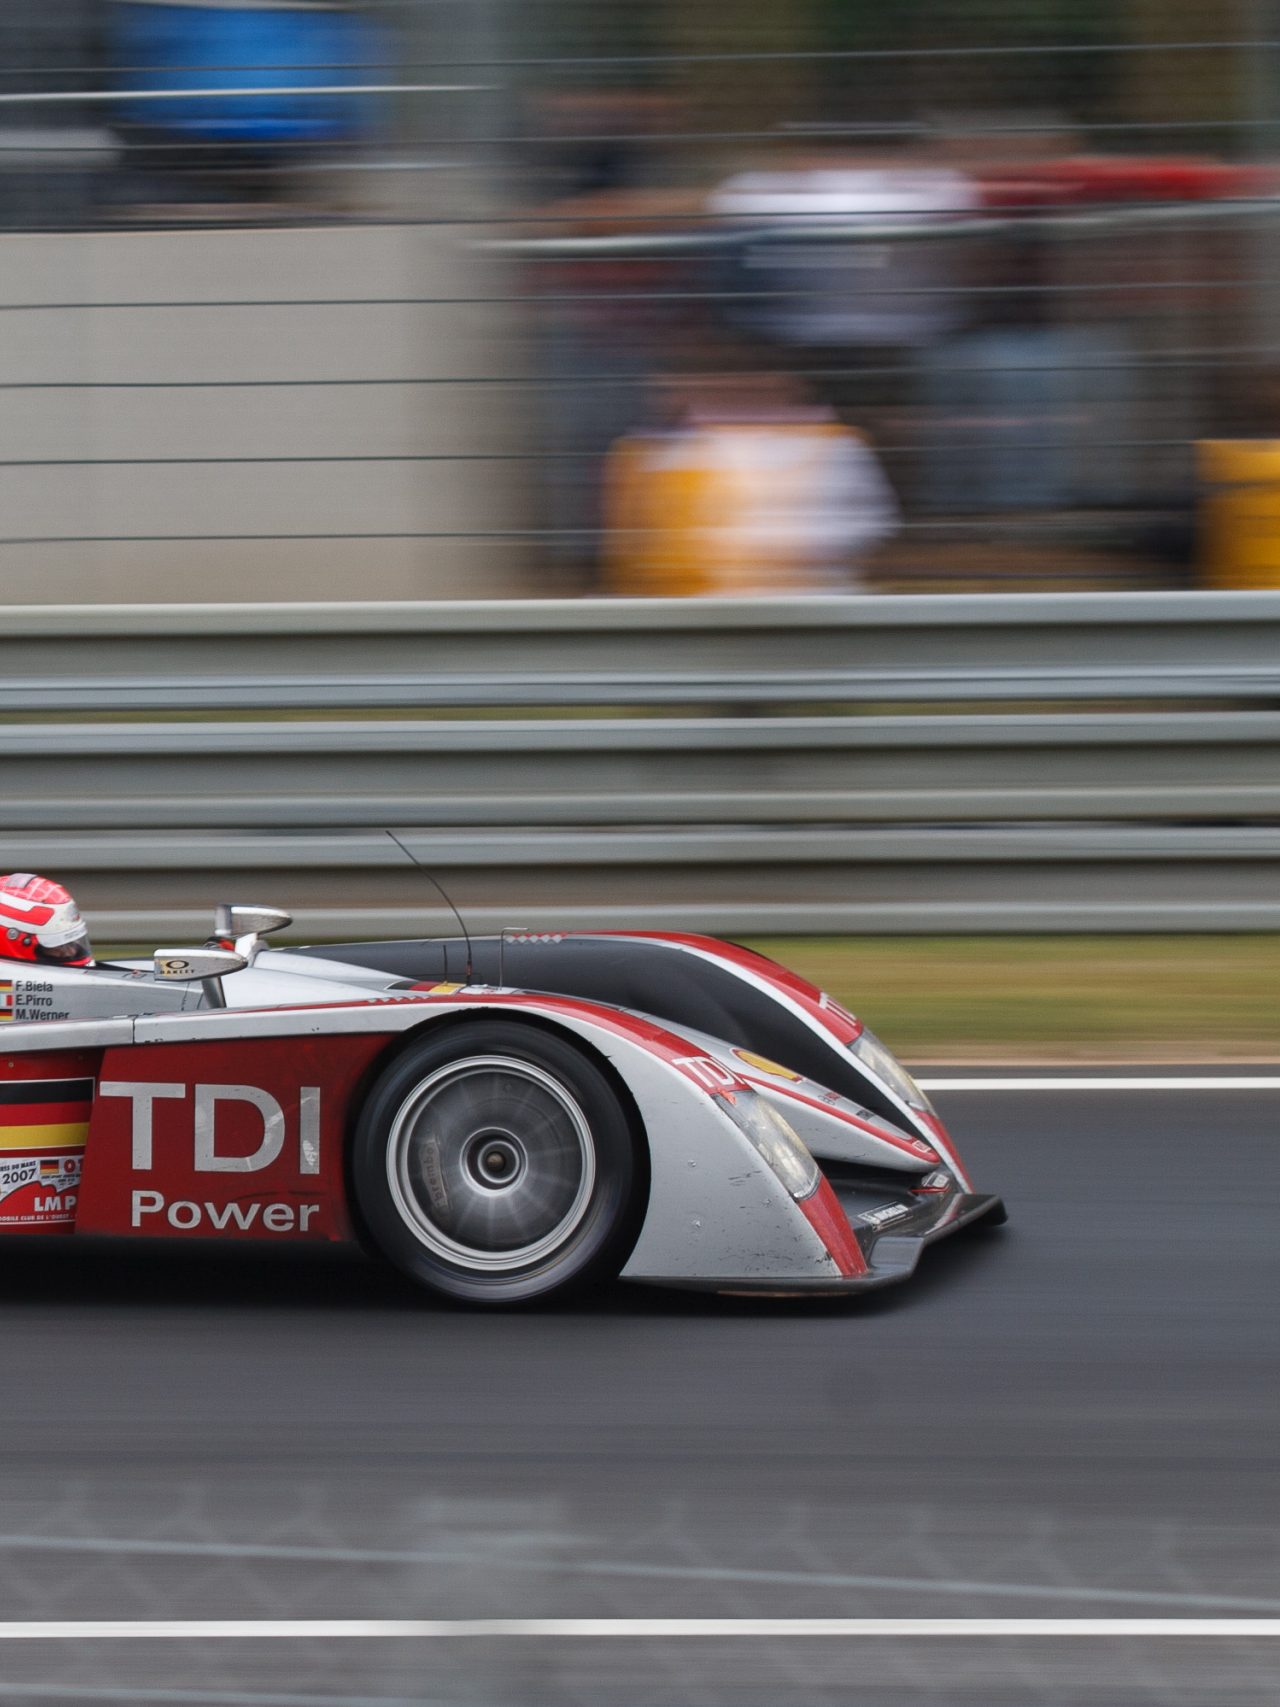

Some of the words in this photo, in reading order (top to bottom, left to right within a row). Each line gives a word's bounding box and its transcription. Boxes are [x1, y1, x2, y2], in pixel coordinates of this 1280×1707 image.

[15, 980, 54, 993] F.Biela
[15, 994, 53, 1007] E.Pirro
[15, 1008, 70, 1021] M.Werner
[671, 1055, 746, 1088] TDI
[99, 1081, 321, 1175] TDI
[2, 1168, 37, 1185] 2007
[131, 1189, 320, 1232] Power
